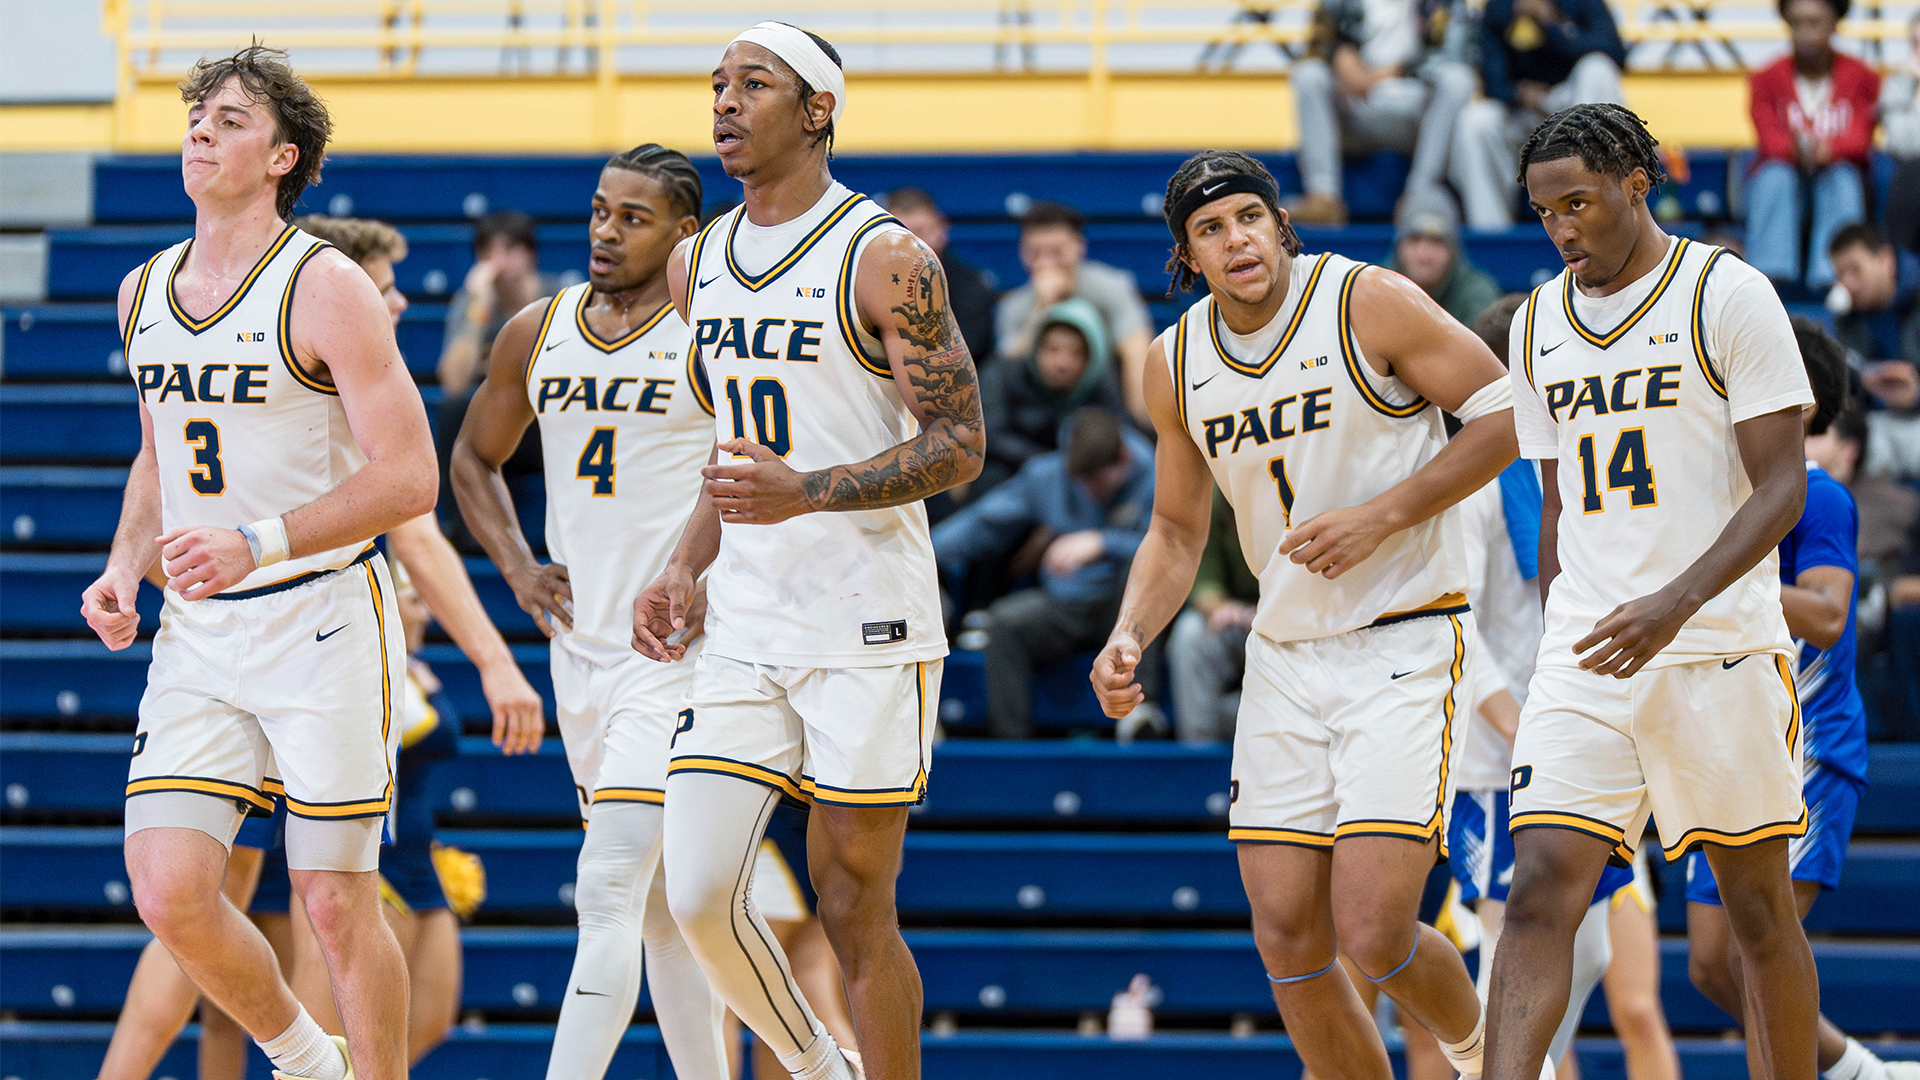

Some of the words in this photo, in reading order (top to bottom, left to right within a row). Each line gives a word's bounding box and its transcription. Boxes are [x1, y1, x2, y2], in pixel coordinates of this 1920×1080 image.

[796, 286, 826, 299] NE10
[237, 331, 265, 343] NE10
[694, 316, 825, 363] PACE
[1649, 333, 1679, 346] NE10
[137, 362, 270, 404] PACE
[1300, 355, 1328, 371] NE10
[537, 376, 677, 415] PACE
[1543, 363, 1683, 425] PACE
[724, 376, 794, 460] 10
[1201, 386, 1334, 459] PACE
[183, 417, 227, 497] 3
[575, 425, 618, 498] 4
[1576, 425, 1660, 516] 14
[1266, 455, 1296, 530] 1
[895, 627, 902, 636] L
[669, 707, 695, 750] P
[1509, 763, 1534, 808] P
